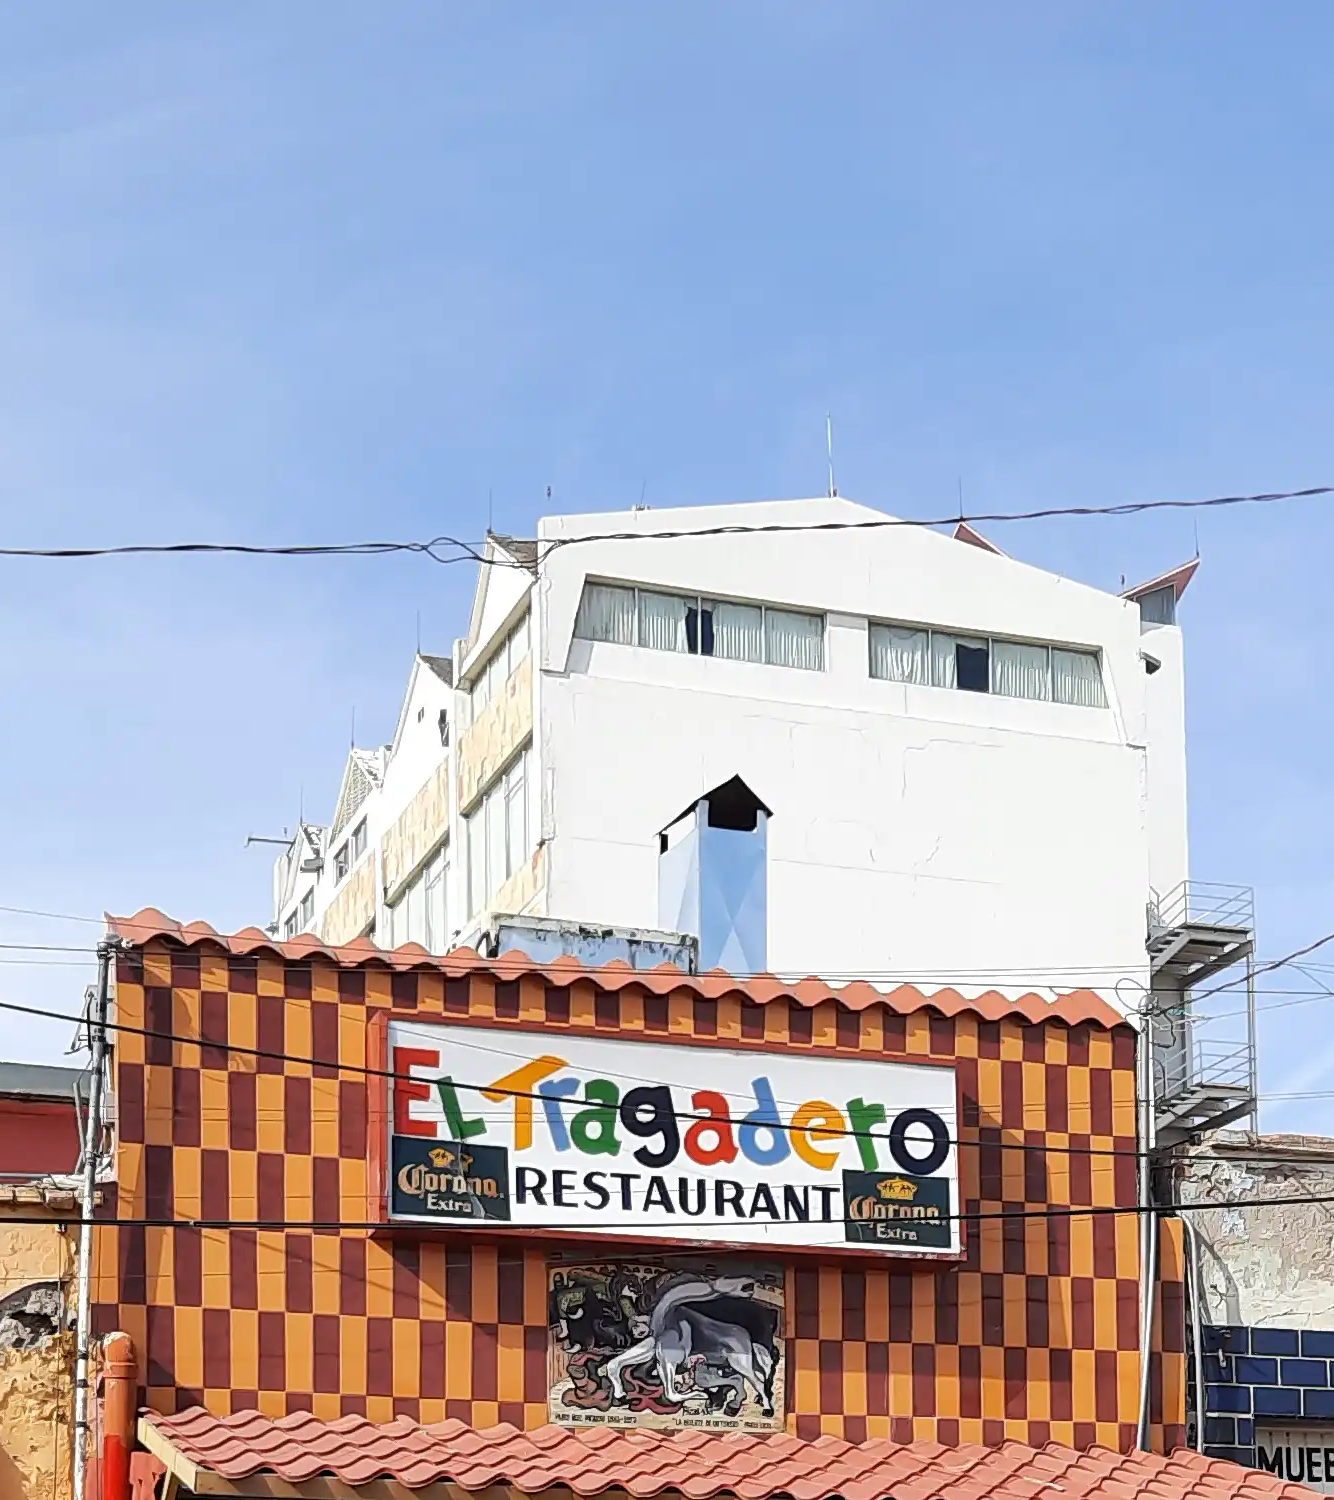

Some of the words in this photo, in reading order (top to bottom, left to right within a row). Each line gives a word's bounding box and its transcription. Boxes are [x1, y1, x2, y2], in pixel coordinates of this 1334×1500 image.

[392, 1045, 487, 1140] EL
[481, 1055, 950, 1176] Tragadero
[427, 1194, 472, 1213] Extra
[515, 1165, 841, 1222] RESTAURANT
[876, 1223, 918, 1241] Extra
